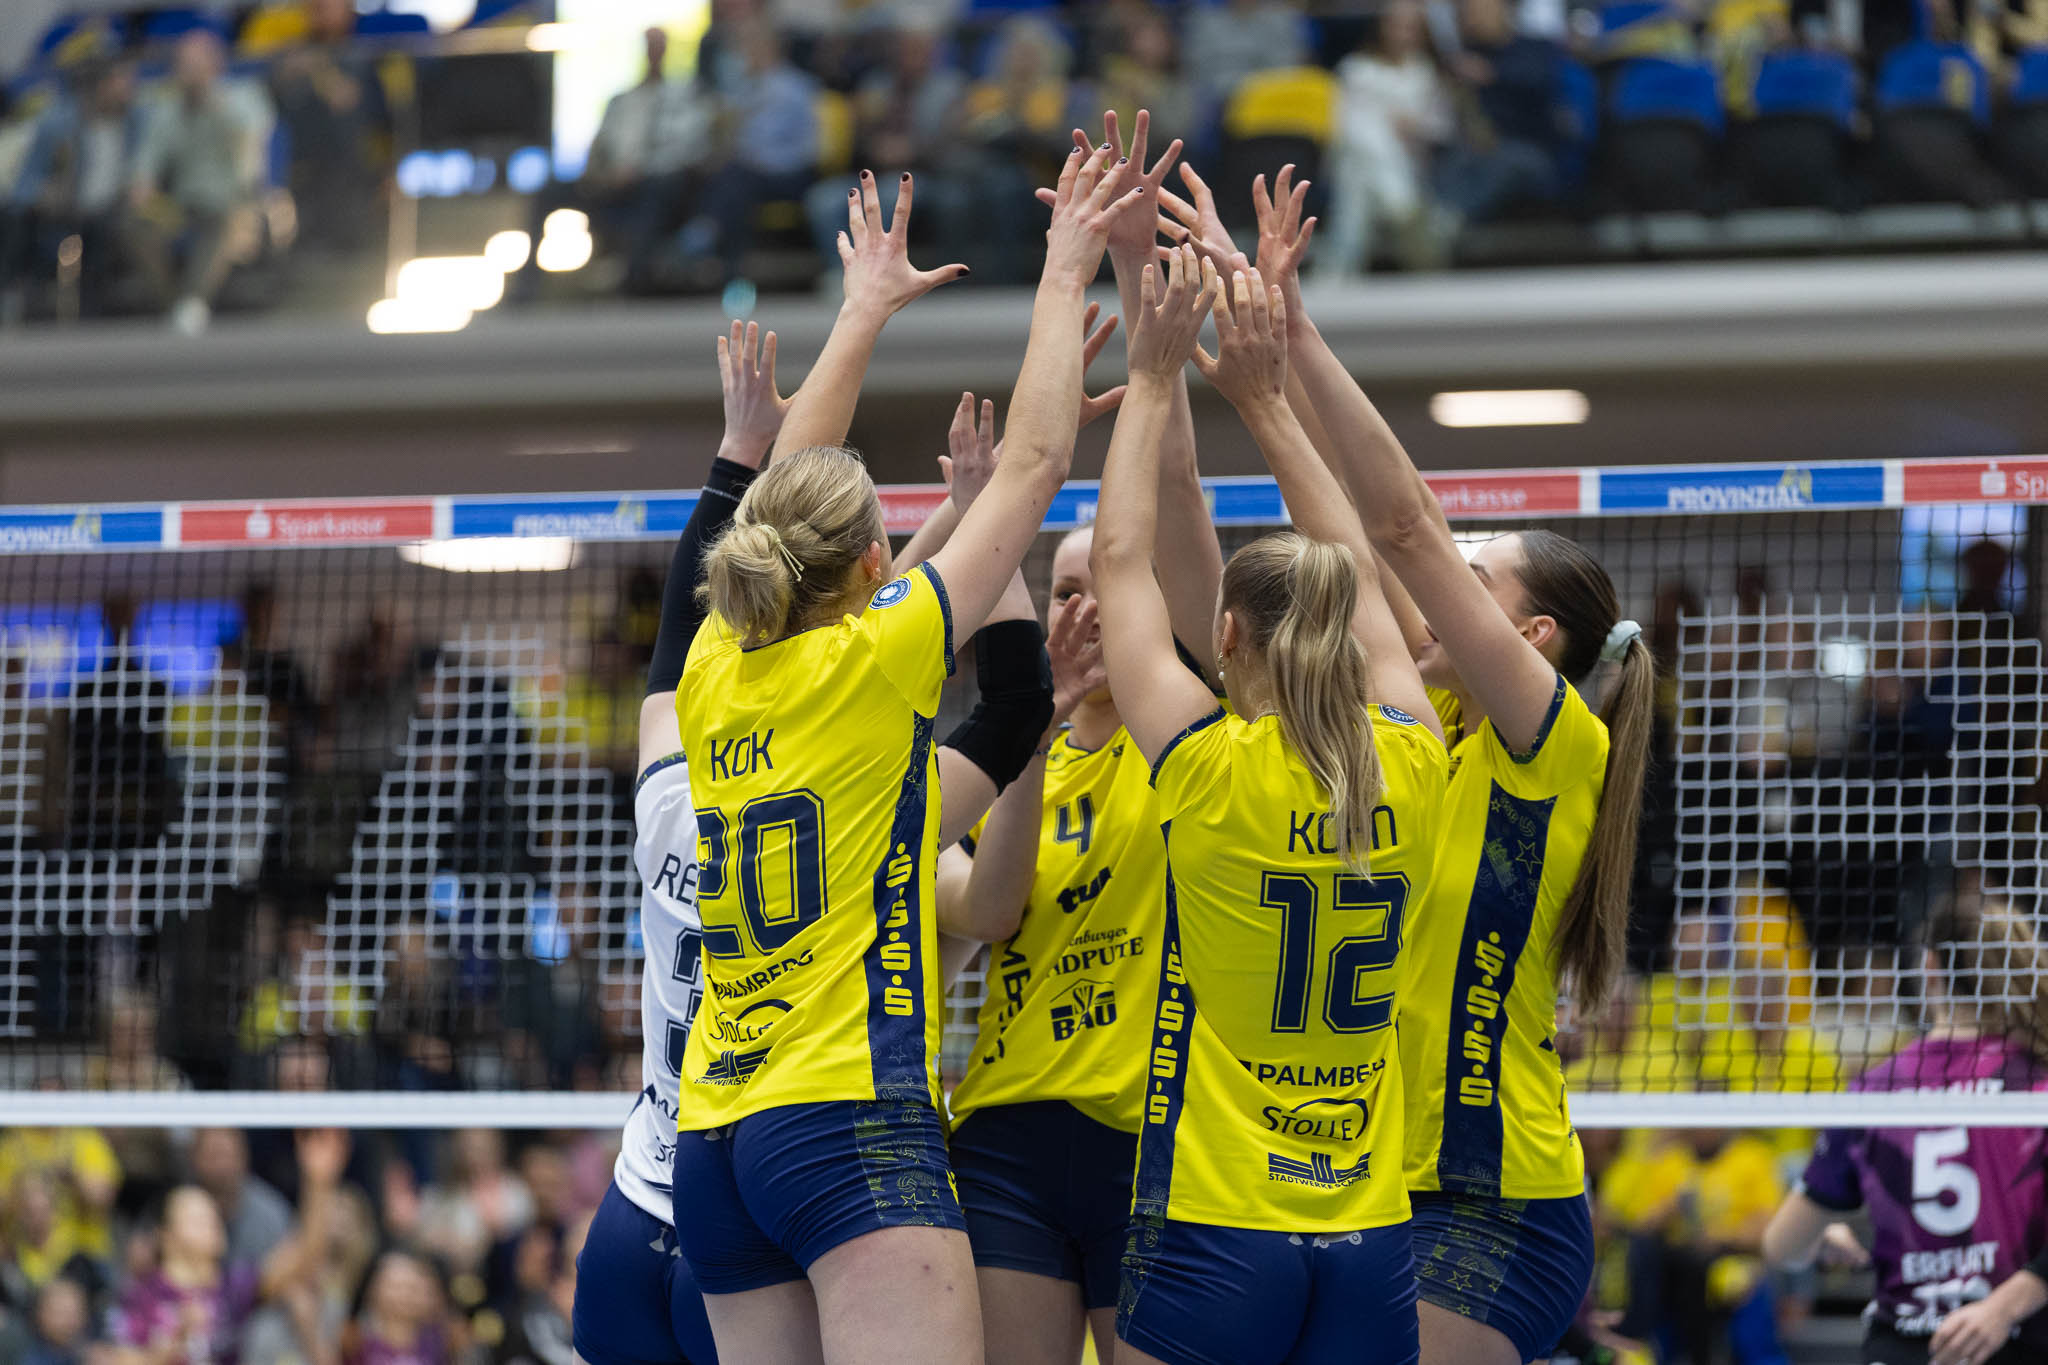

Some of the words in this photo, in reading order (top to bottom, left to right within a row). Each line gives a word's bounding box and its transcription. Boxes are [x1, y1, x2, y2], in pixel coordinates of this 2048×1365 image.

[1668, 484, 1806, 512] PROVINZIAL
[275, 510, 388, 545] Sparkasse
[711, 728, 775, 781] KOK
[1053, 792, 1096, 857] 4
[695, 787, 829, 961] 20
[1259, 870, 1411, 1034] 12
[1052, 1002, 1118, 1042] BAU
[1262, 1106, 1354, 1141] STOLLE
[1268, 1172, 1333, 1190] STADTWERKE
[1911, 1126, 1981, 1237] 5
